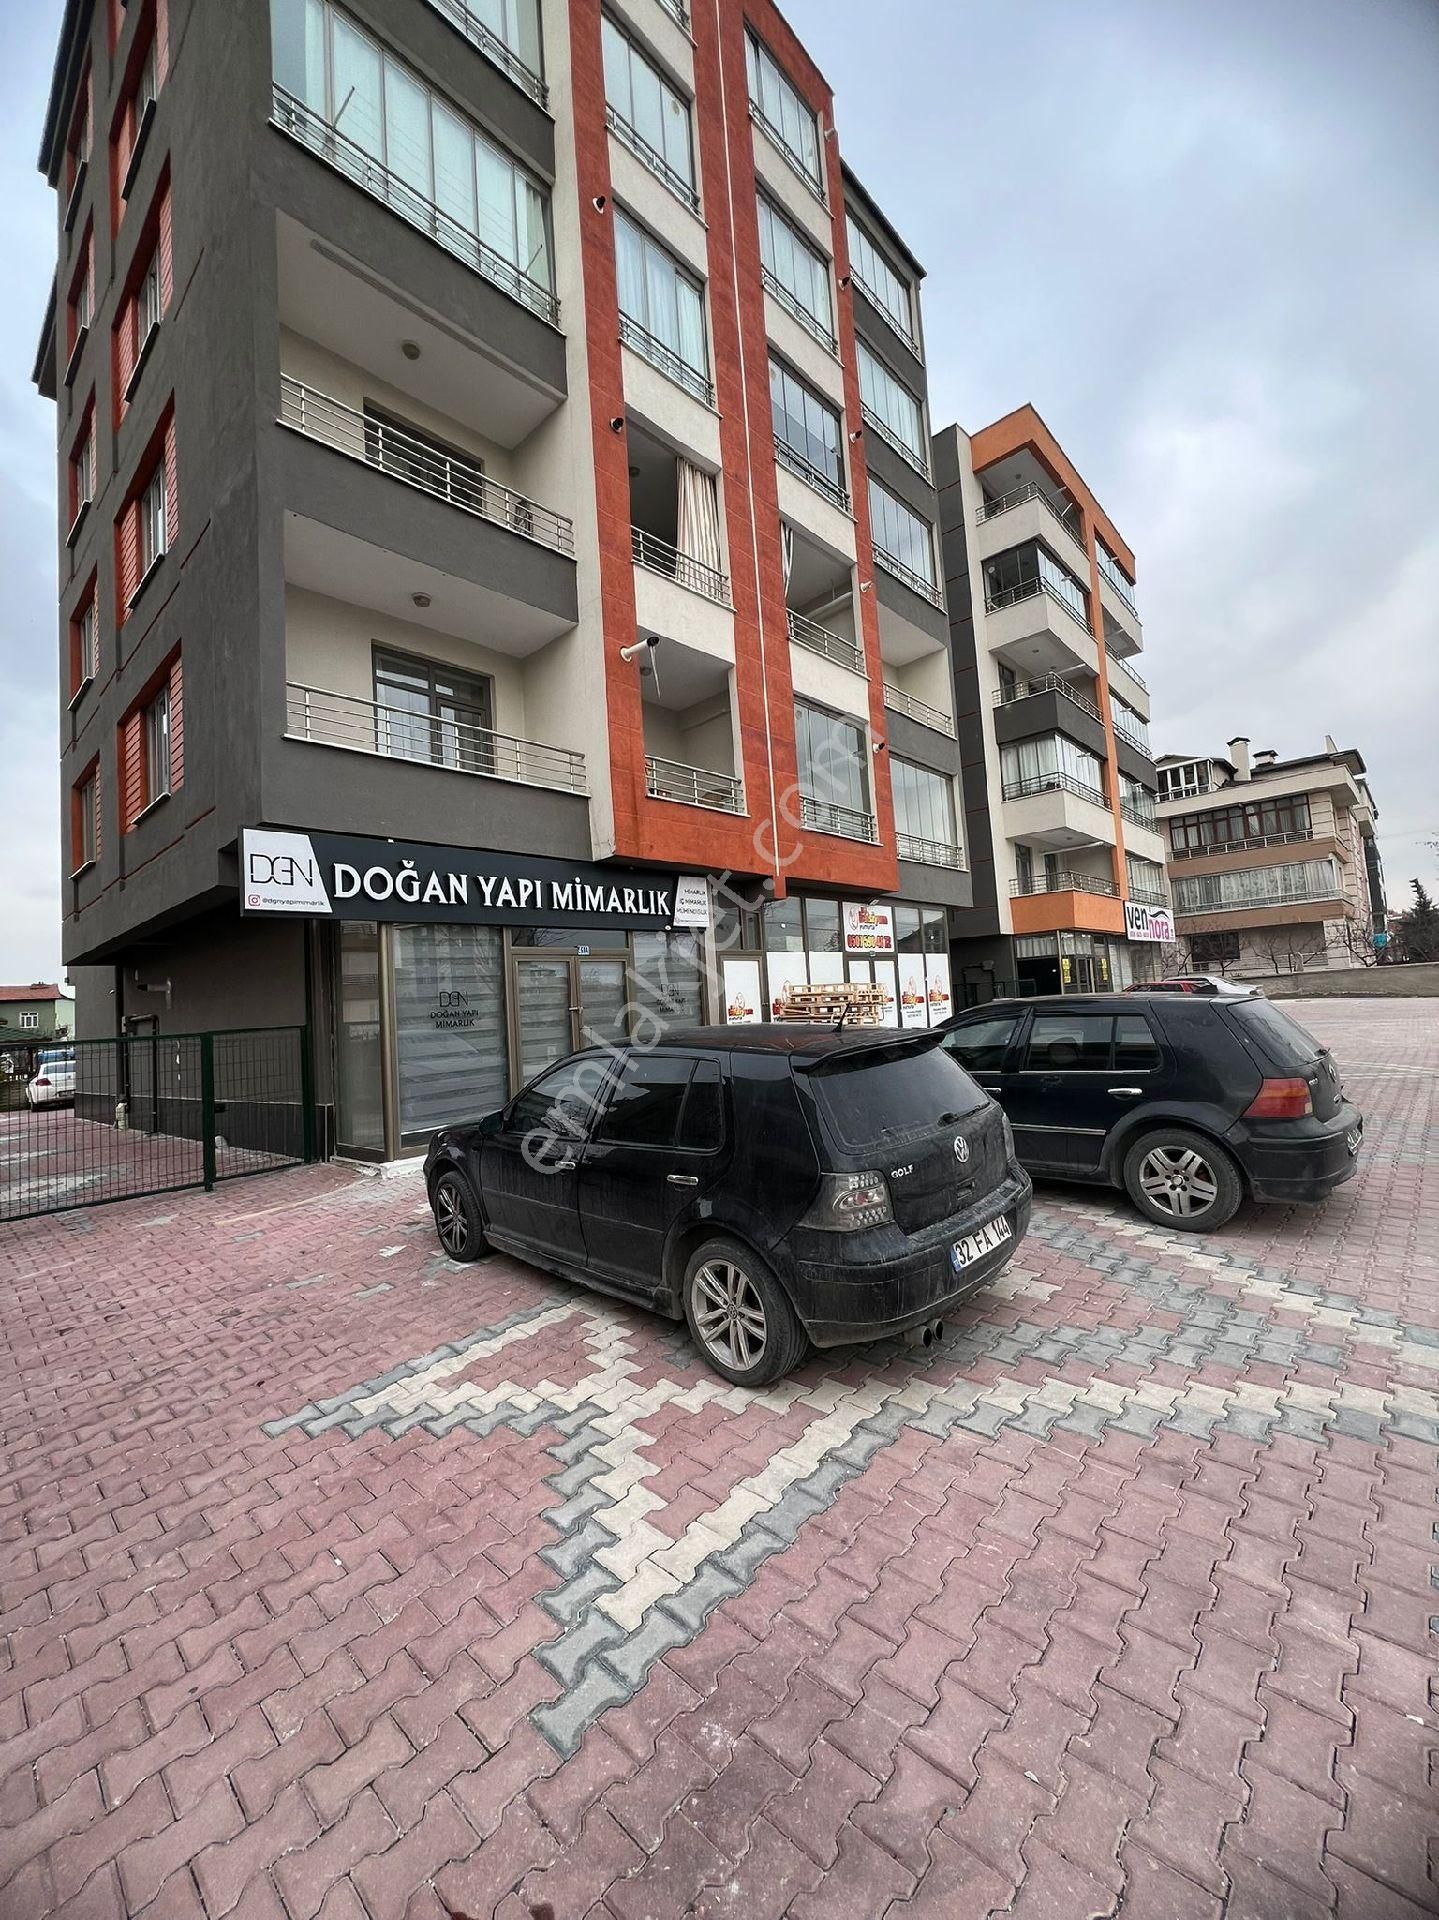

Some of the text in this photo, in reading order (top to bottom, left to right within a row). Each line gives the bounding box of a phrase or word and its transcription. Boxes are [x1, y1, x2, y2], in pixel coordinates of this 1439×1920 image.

[333, 859, 671, 916] DOĞAN YAPI MİMARLIK
[891, 1164, 914, 1179] GOLF
[955, 1216, 1011, 1265] 32 FA 144
